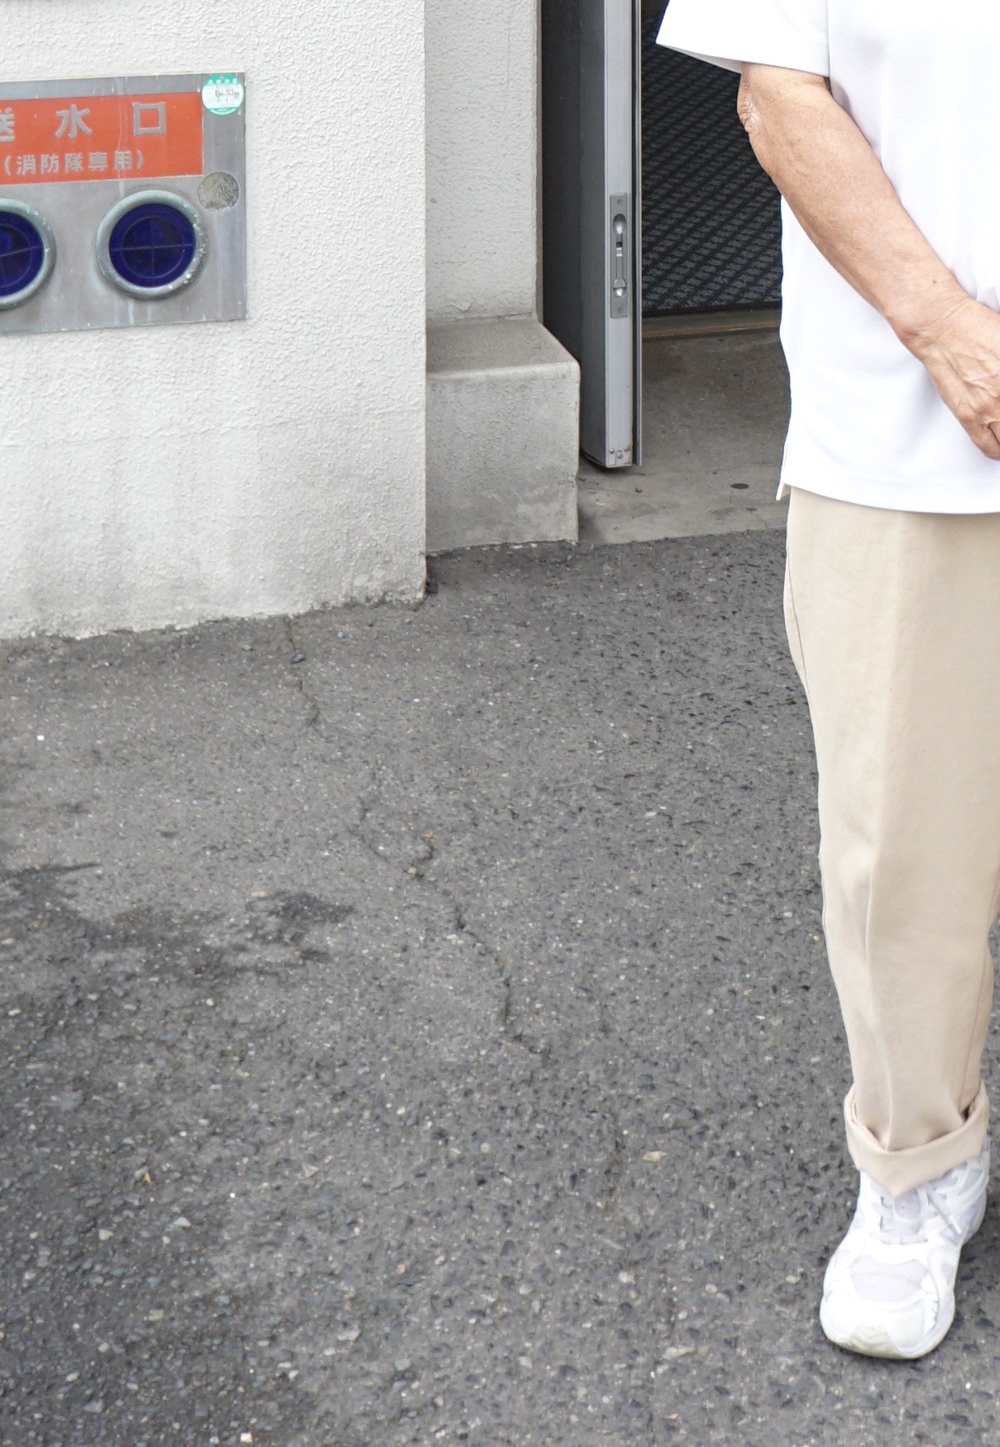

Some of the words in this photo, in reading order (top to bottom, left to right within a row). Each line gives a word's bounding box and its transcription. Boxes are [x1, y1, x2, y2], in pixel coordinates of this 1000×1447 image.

[4, 149, 145, 177] (消防隊専用)
